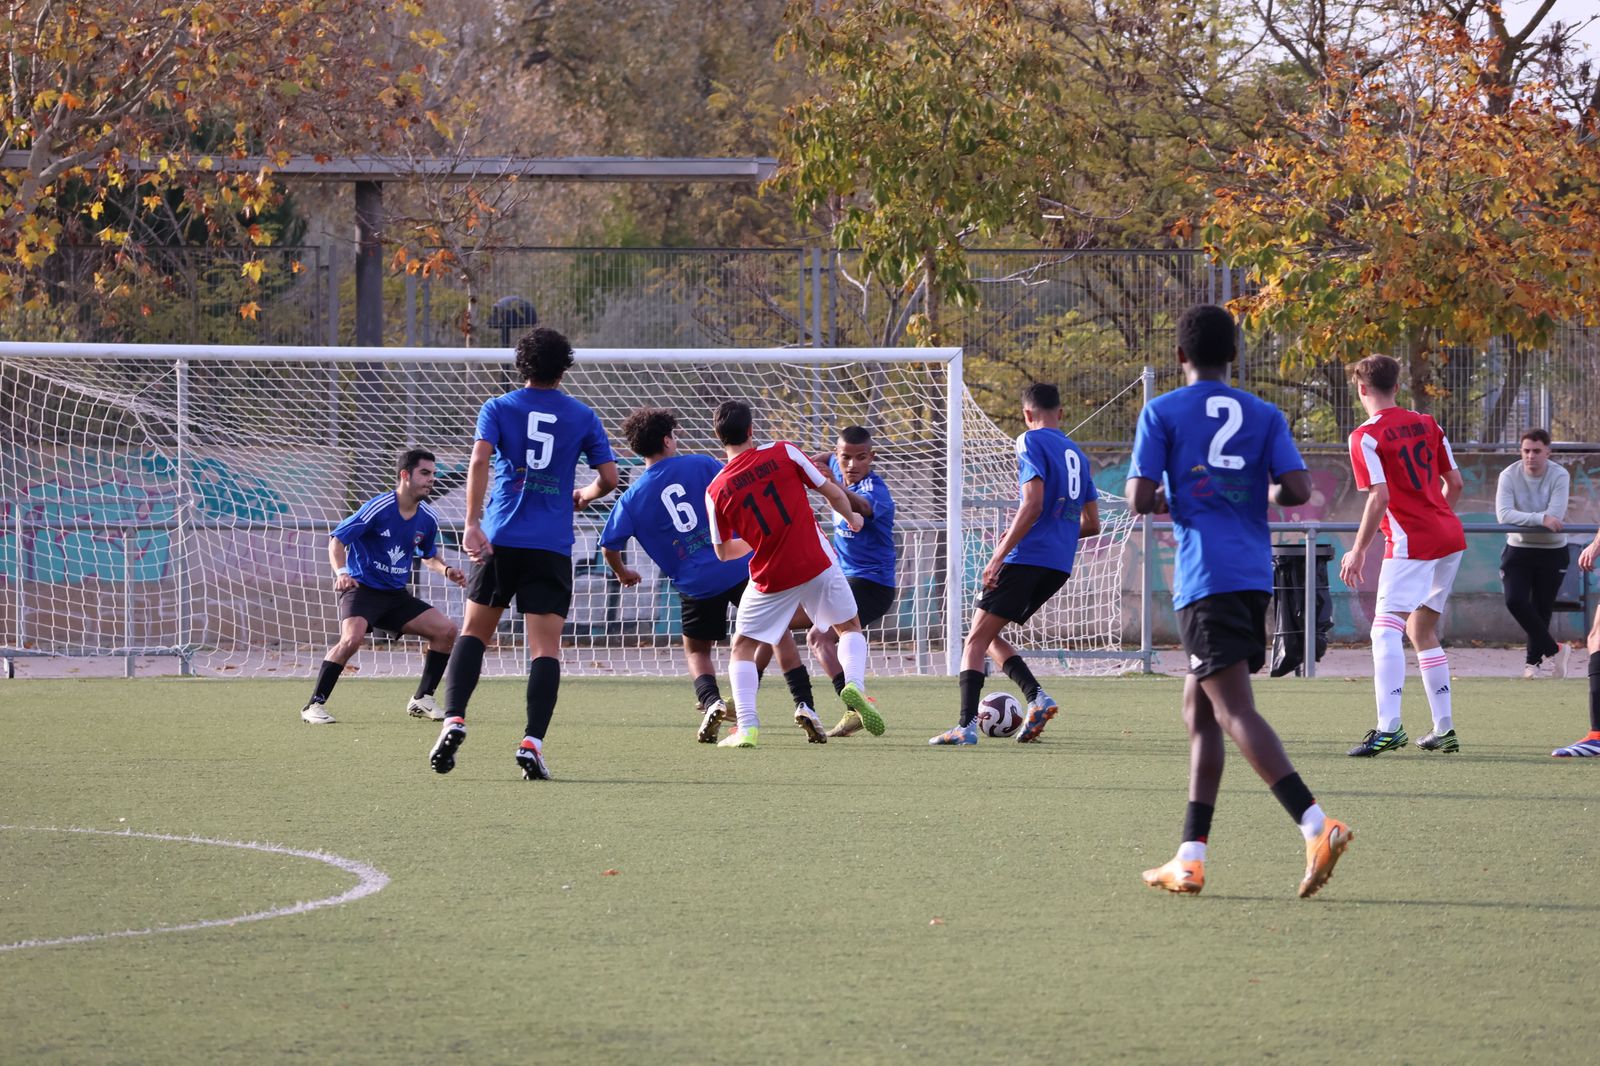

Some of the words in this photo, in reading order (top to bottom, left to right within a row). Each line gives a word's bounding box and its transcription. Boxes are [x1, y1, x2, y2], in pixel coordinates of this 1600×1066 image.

[526, 411, 558, 470] 5
[1206, 396, 1246, 470] 2
[1064, 448, 1081, 500] 8
[1398, 440, 1433, 489] 19
[660, 483, 698, 533] 6
[743, 481, 792, 537] 11
